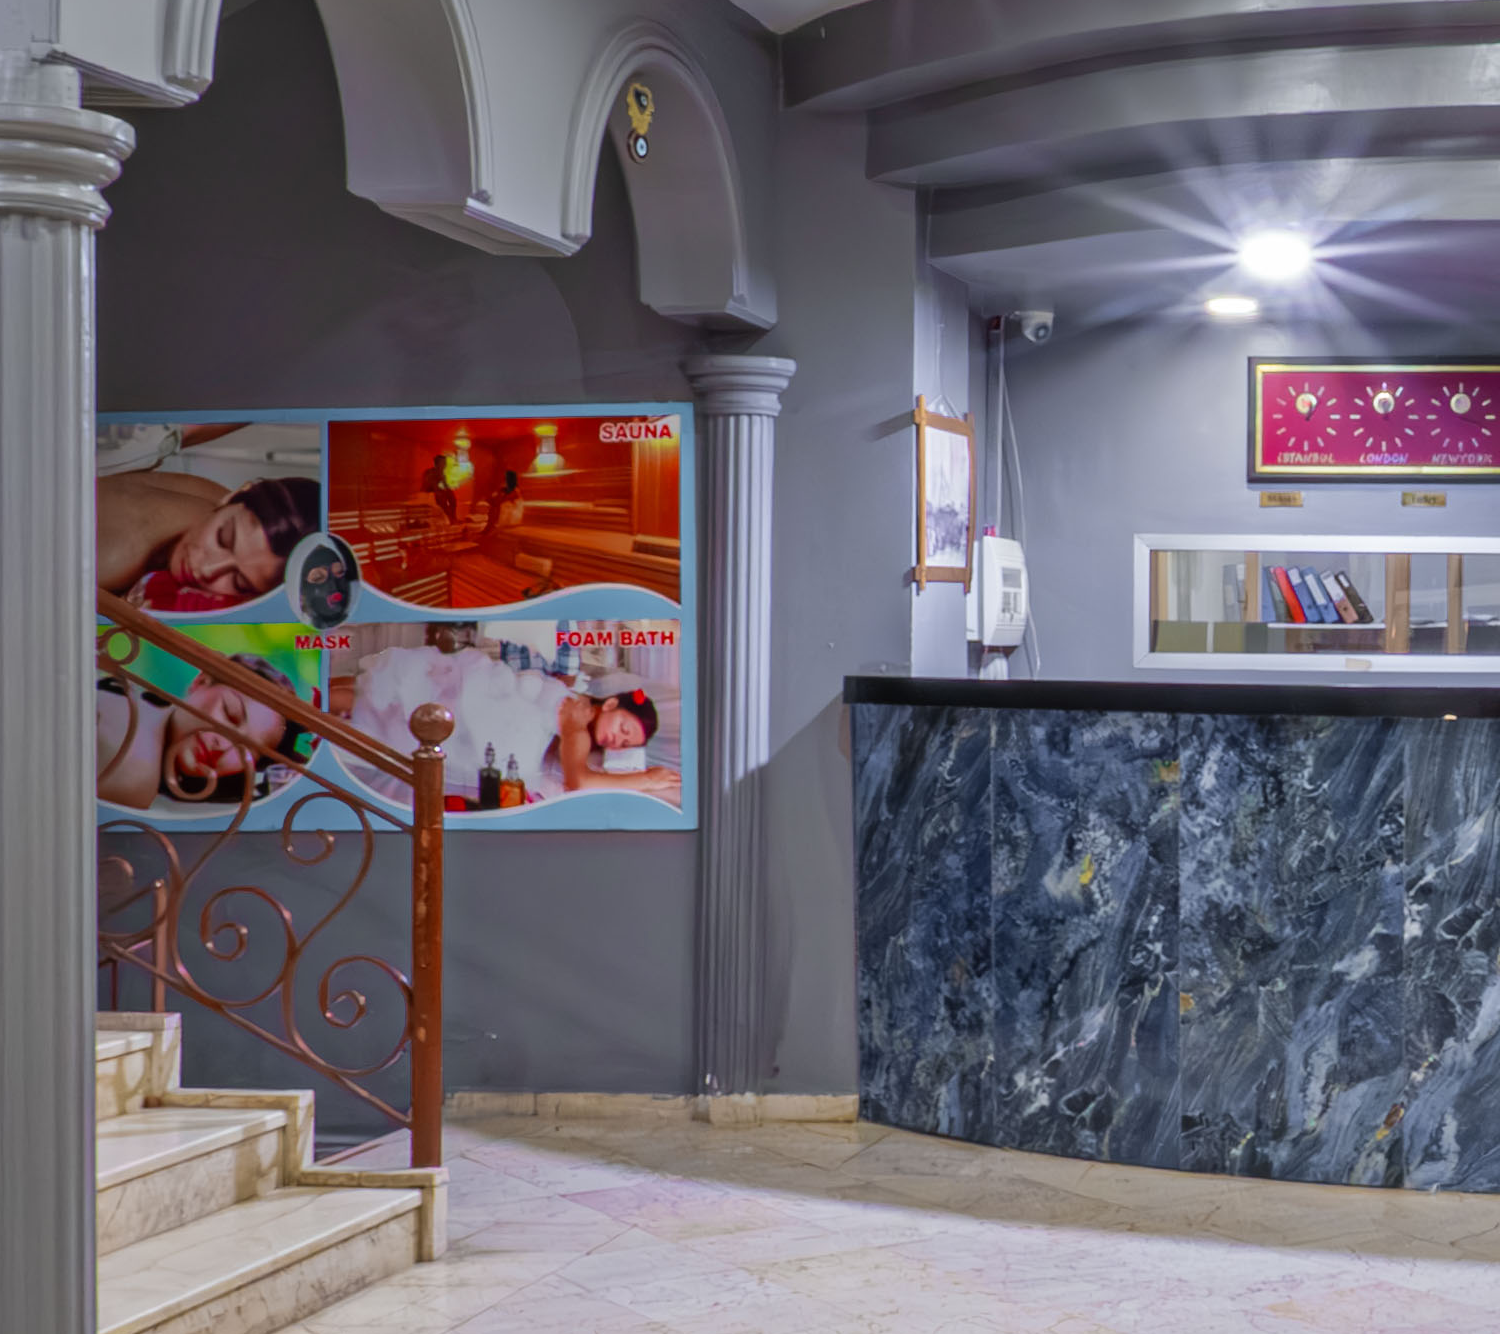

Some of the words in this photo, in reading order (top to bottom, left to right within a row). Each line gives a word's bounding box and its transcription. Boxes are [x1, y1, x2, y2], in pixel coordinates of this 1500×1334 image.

[601, 423, 673, 441] SAUNA
[1359, 452, 1409, 464] LONDON
[295, 634, 351, 650] MASK
[556, 631, 613, 647] FOAM
[620, 630, 674, 646] BATH
